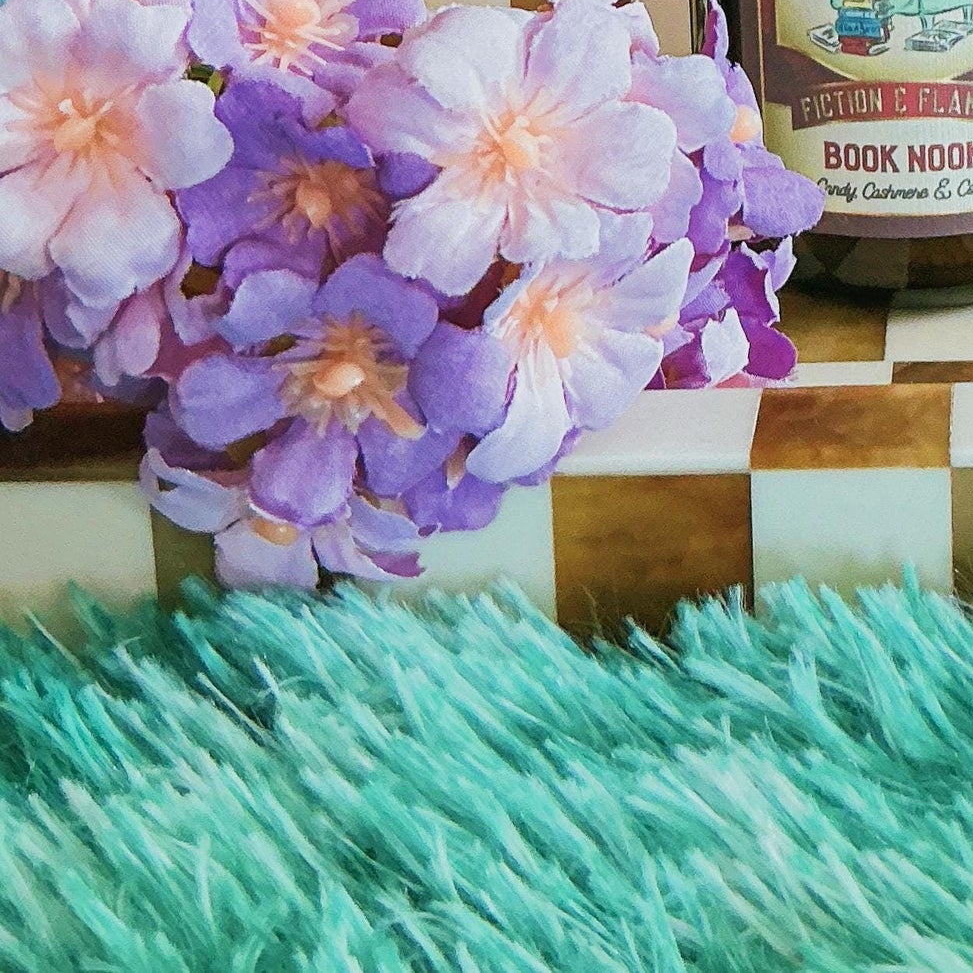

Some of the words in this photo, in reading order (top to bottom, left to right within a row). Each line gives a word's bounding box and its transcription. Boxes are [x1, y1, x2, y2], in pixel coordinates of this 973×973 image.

[800, 86, 883, 122] FICTION
[823, 140, 900, 174] BOOK
[862, 181, 929, 201] Cashmere
[933, 177, 952, 200] &
